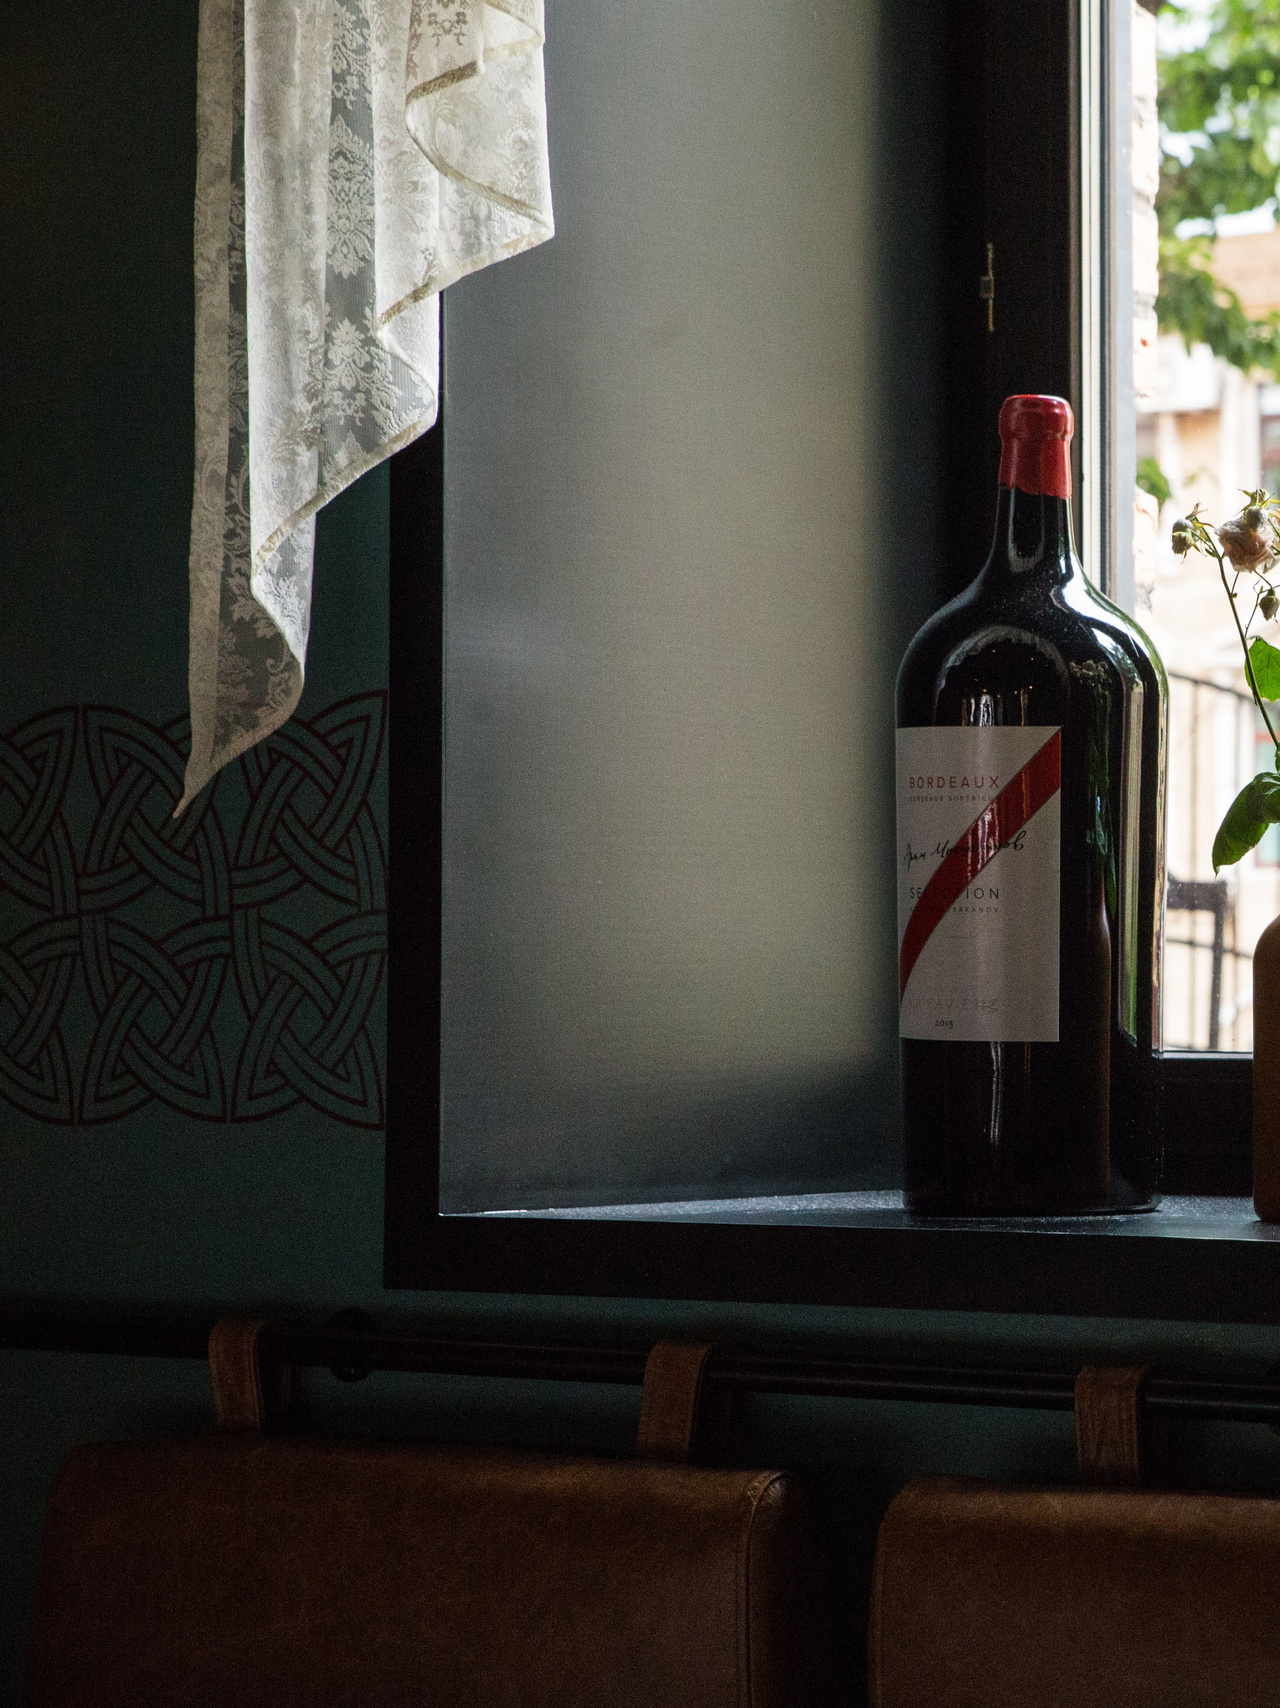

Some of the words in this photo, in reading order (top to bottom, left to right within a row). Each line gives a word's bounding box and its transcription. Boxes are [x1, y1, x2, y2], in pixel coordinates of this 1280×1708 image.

[908, 776, 1000, 789] BORDEAUX
[948, 794, 998, 802] SUPÉRIEU
[909, 887, 1000, 900] SELECTION
[934, 1019, 954, 1029] 2015
